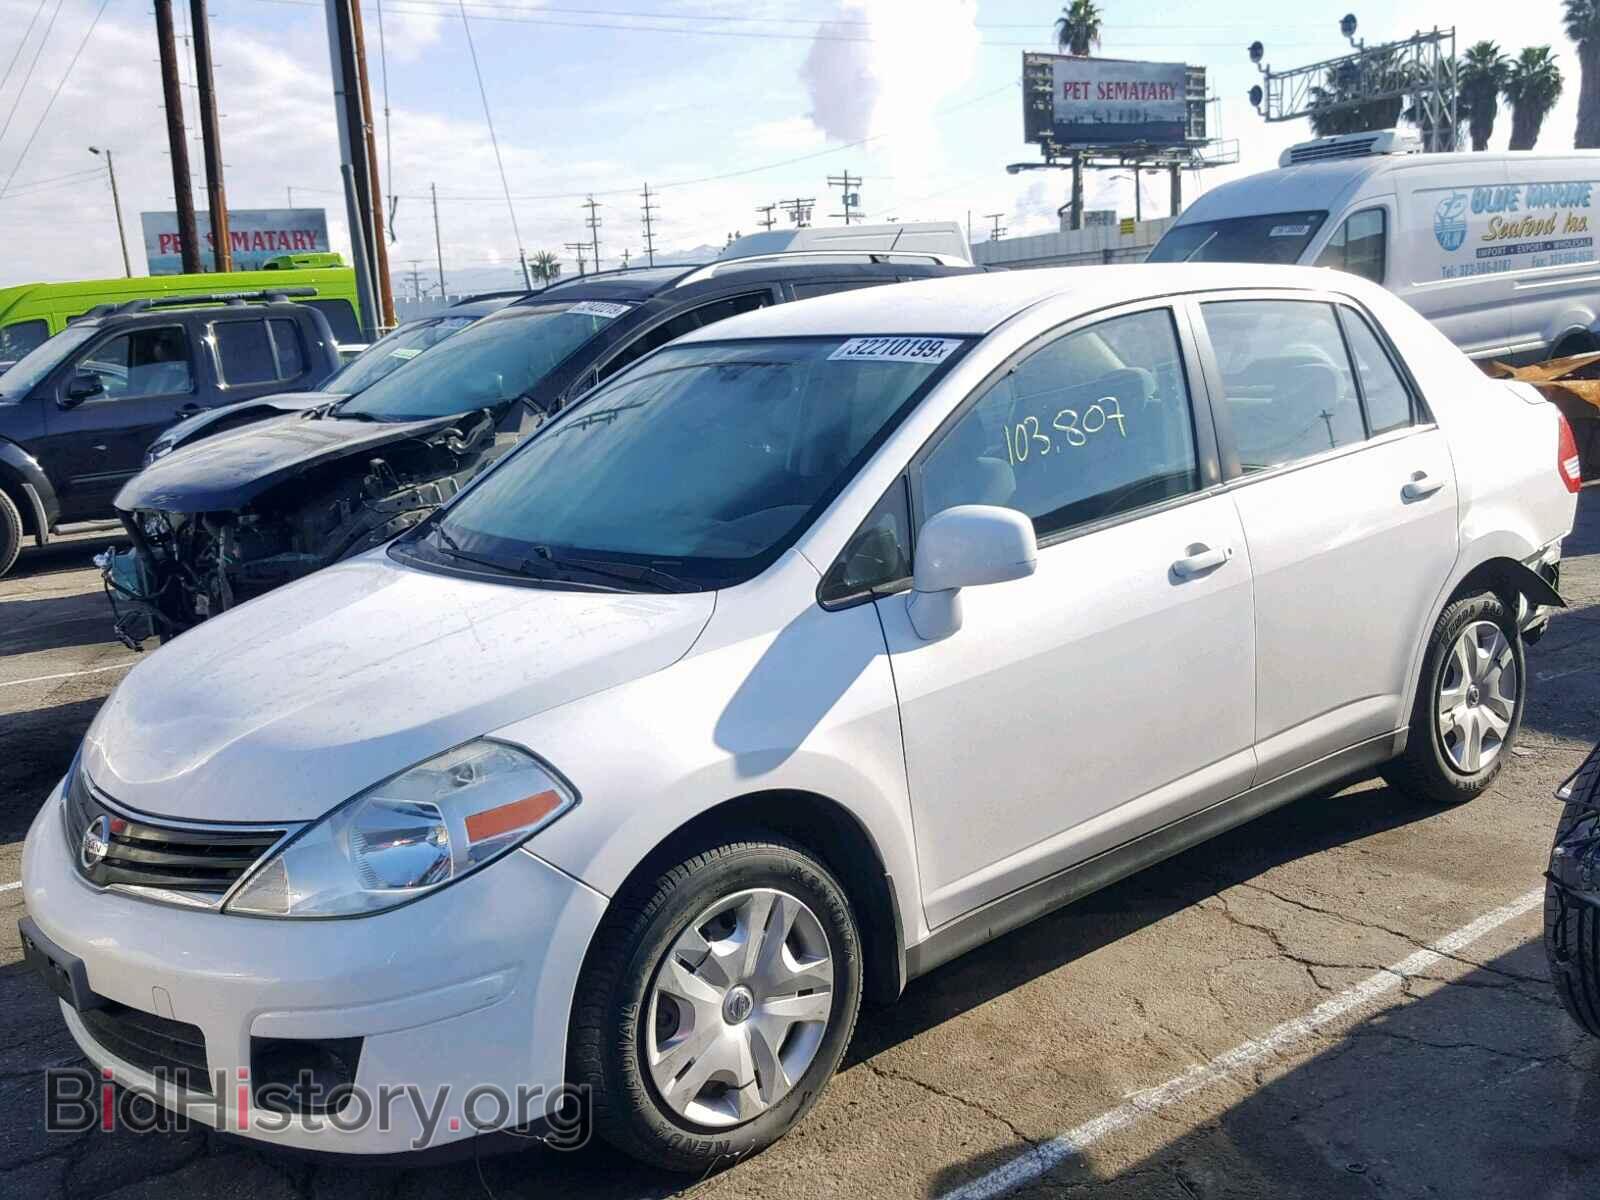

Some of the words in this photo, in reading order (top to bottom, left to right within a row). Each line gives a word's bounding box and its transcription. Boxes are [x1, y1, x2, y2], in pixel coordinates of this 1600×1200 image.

[1063, 81, 1091, 101] PET
[1097, 81, 1178, 101] SEMATARY
[1481, 211, 1557, 241] Seafood
[206, 229, 318, 253] SMATARY
